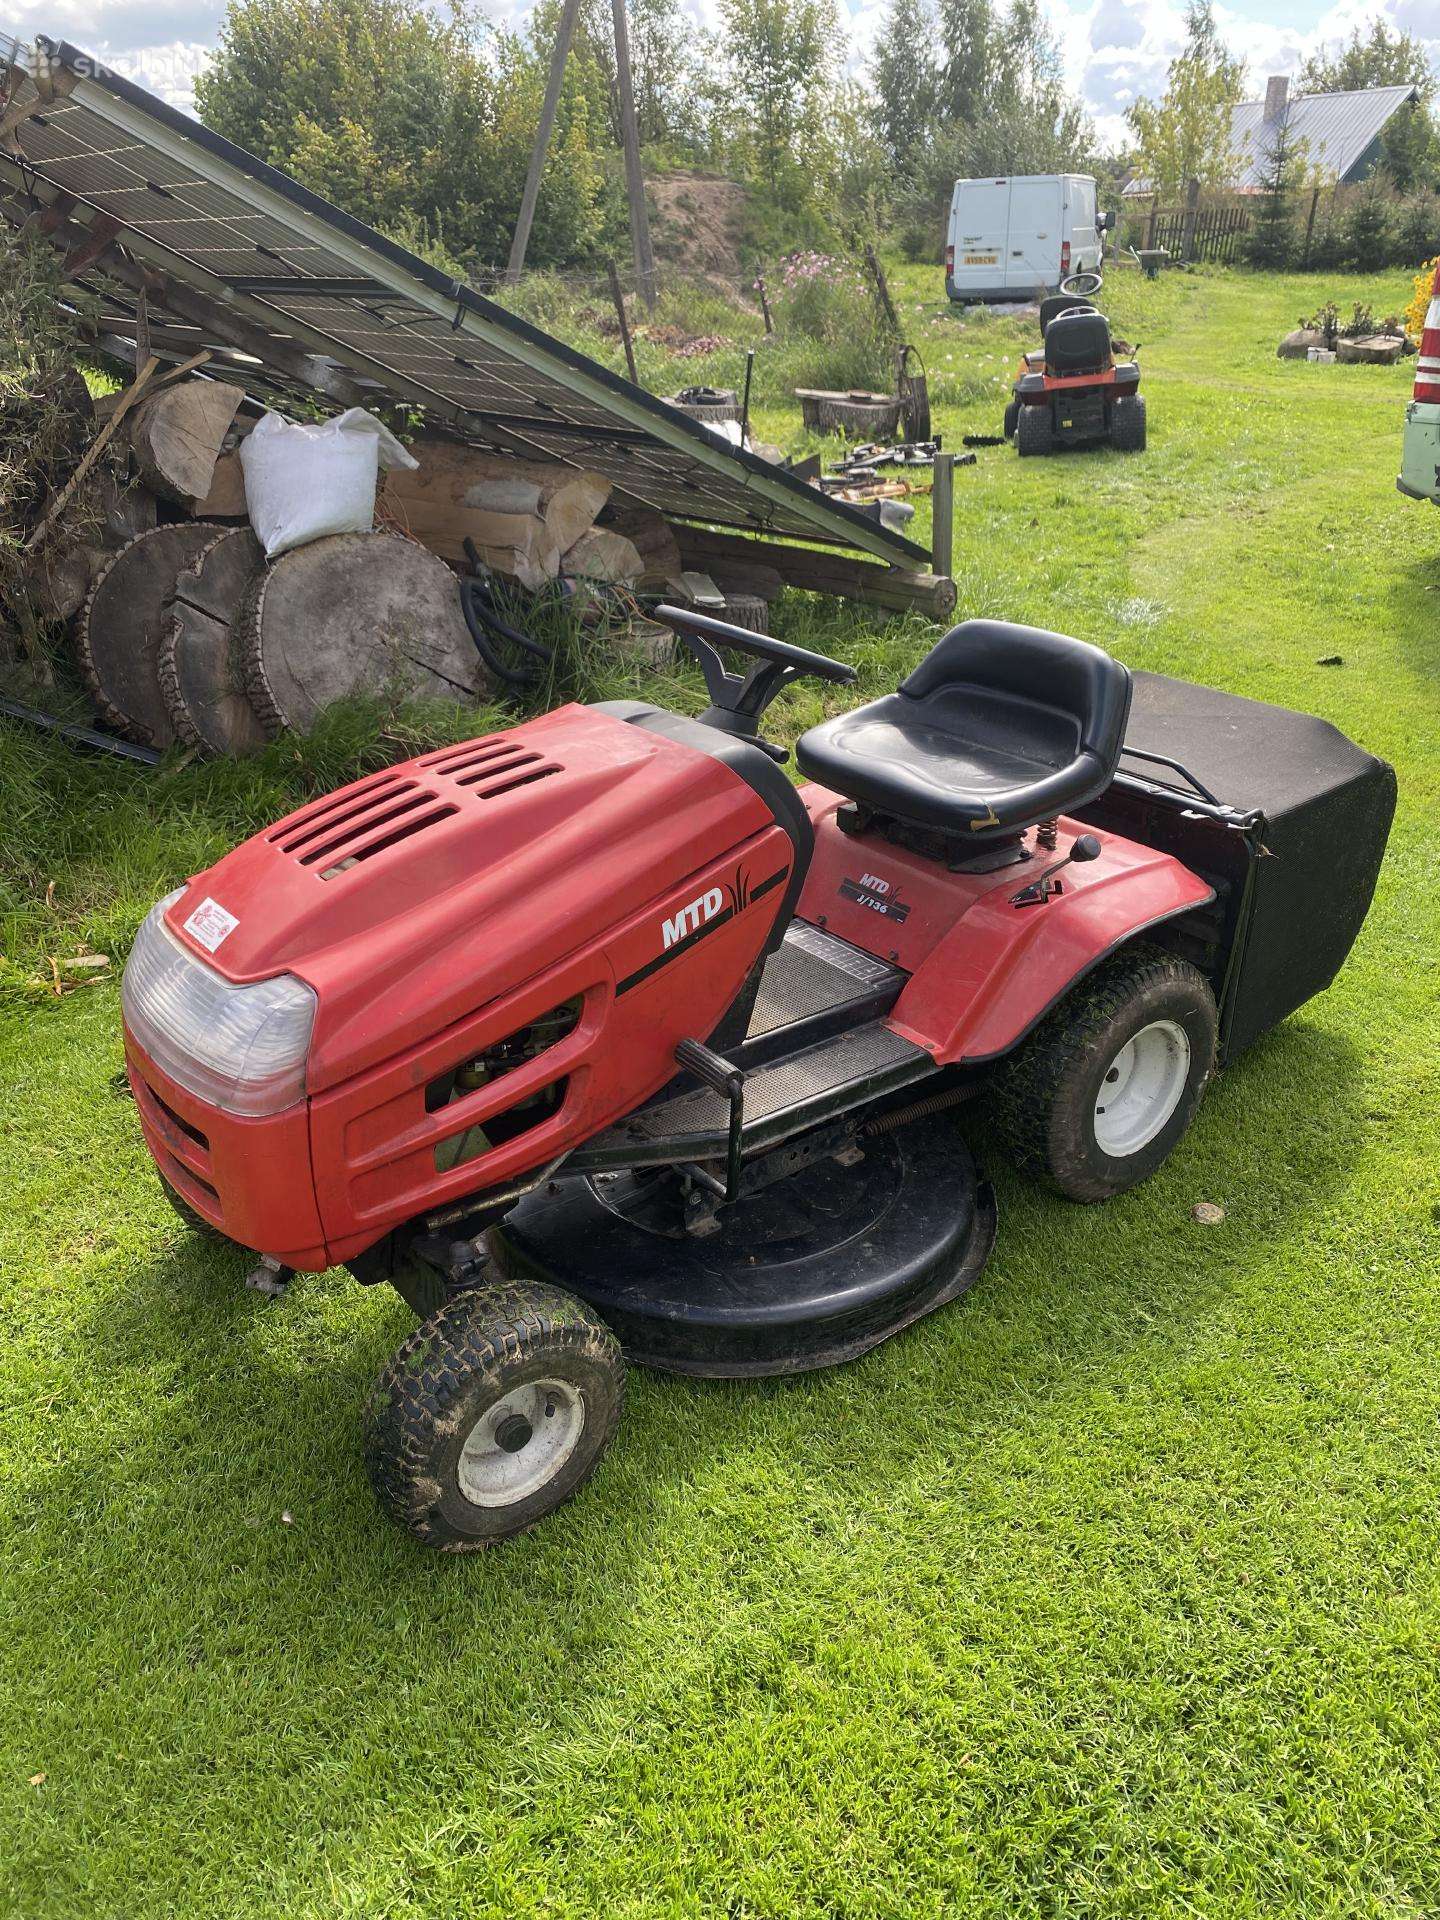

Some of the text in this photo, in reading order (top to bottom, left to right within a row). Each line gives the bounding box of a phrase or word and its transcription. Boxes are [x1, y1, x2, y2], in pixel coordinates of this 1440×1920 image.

[859, 873, 890, 894] MTD
[856, 894, 889, 914] J/136
[661, 887, 723, 949] MTD
